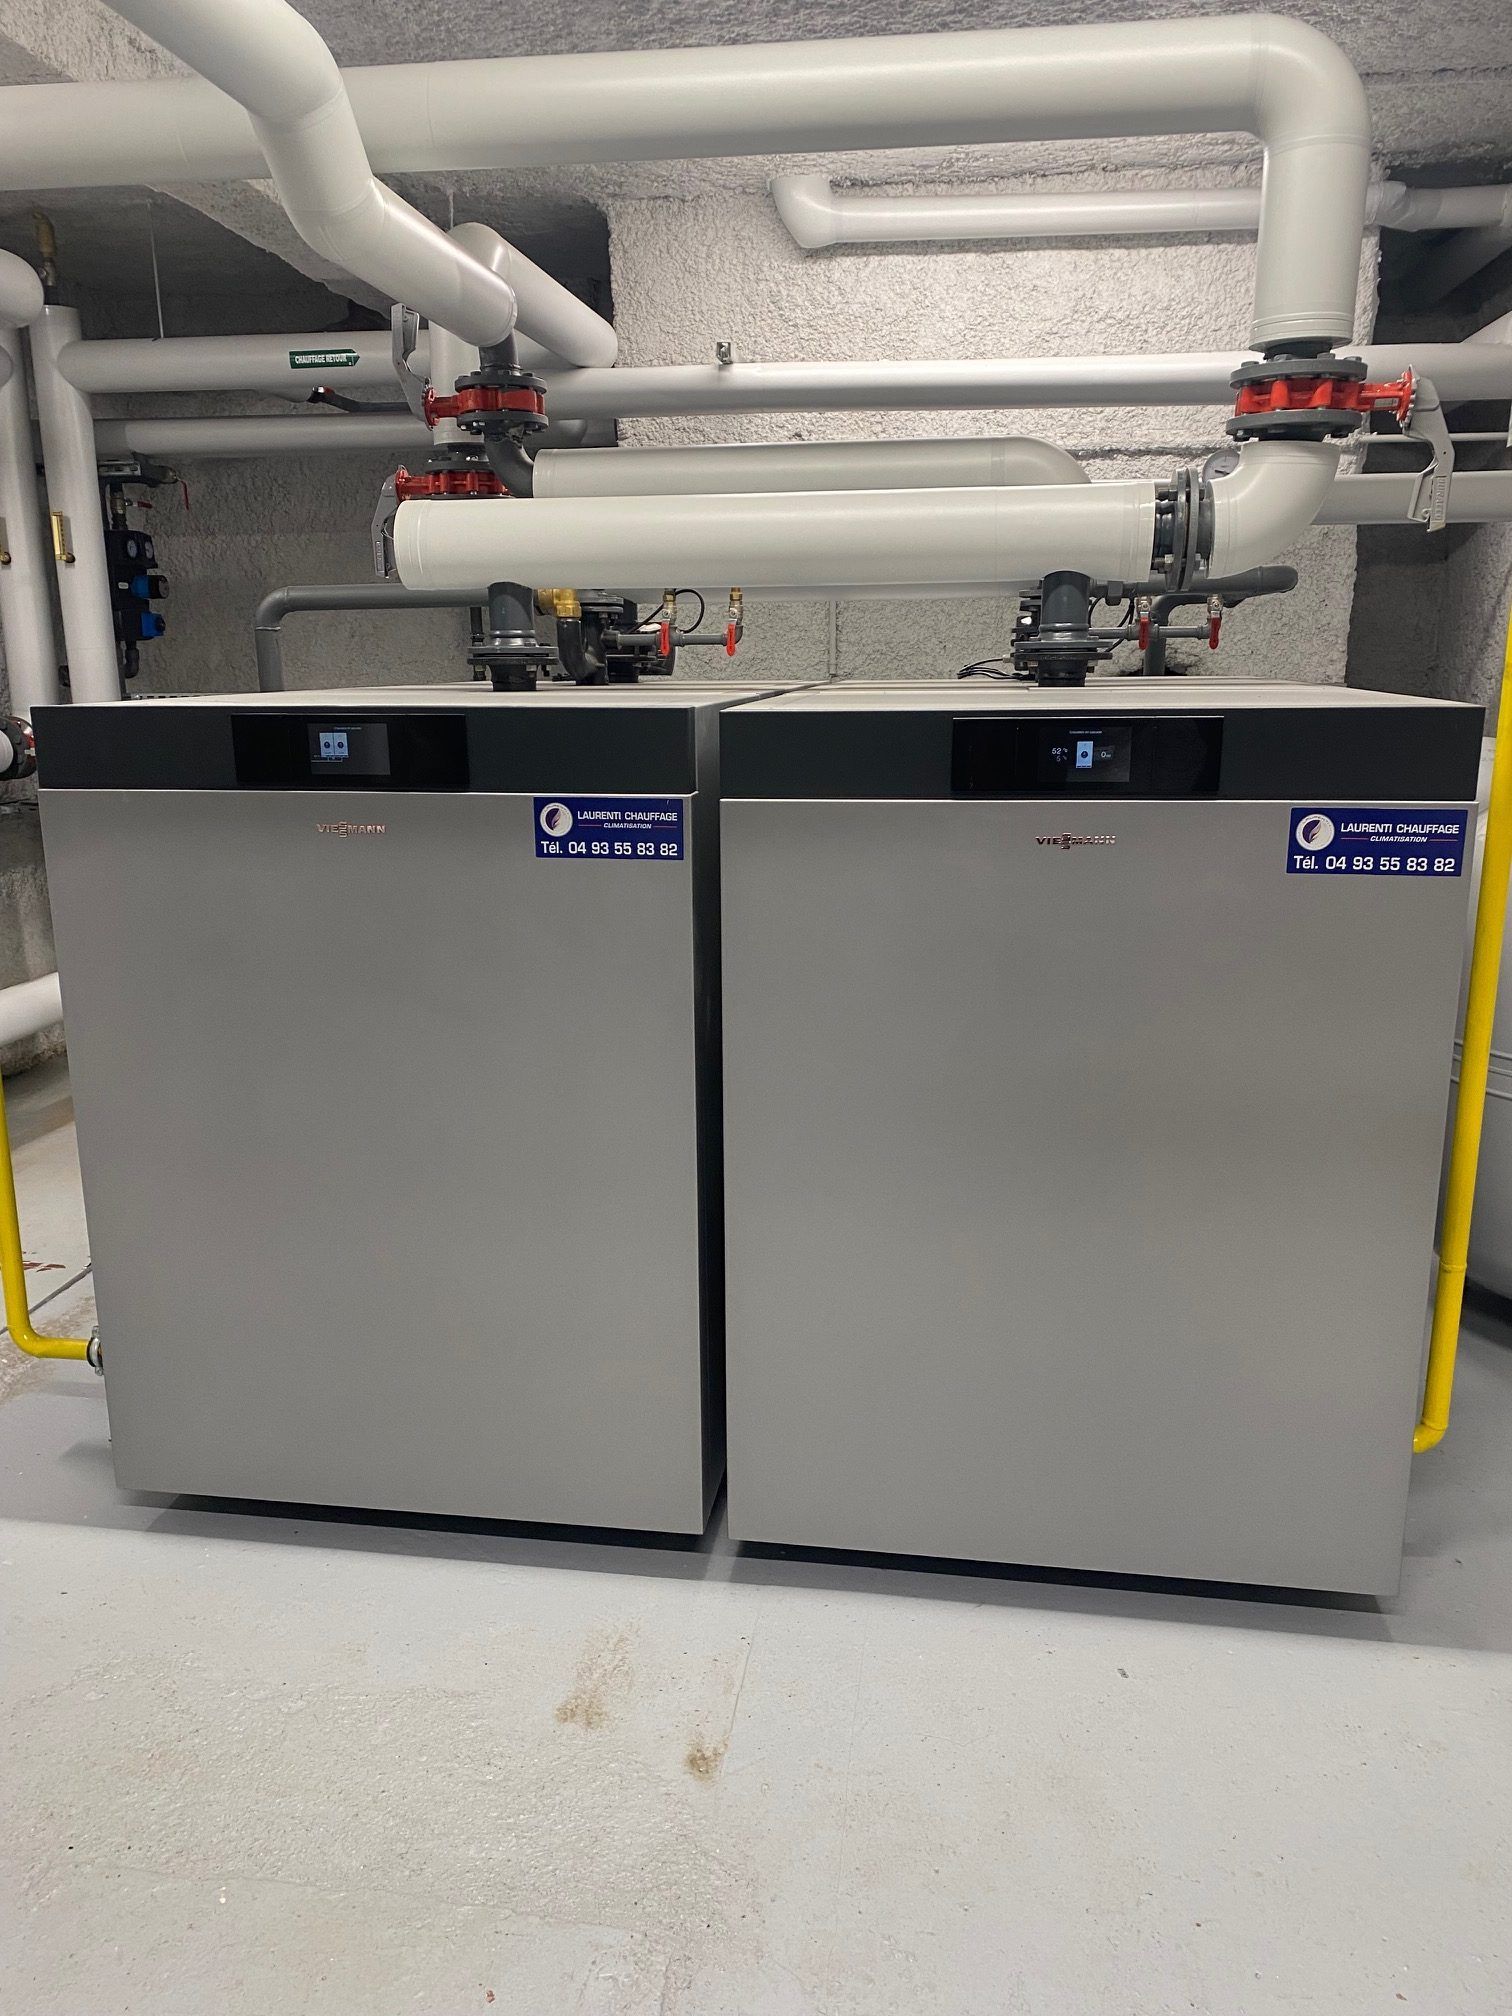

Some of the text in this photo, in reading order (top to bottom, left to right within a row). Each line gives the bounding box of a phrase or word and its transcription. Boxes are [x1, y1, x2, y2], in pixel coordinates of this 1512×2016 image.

[294, 354, 347, 364] CHAUFFAGE RETOUR
[1052, 747, 1062, 755] 52
[577, 810, 622, 820] LAURENTI
[624, 811, 678, 822] CHAUFFAGE
[316, 821, 386, 838] VIESSMANN
[1340, 822, 1393, 833] LAURENTI
[1396, 823, 1460, 834] CHAUFFAGE
[1370, 835, 1428, 843] CLIMATISATION
[540, 840, 678, 856] Tél. 04 93 55 83 82
[1293, 855, 1456, 872] Tél. 04 93 55 83 82
